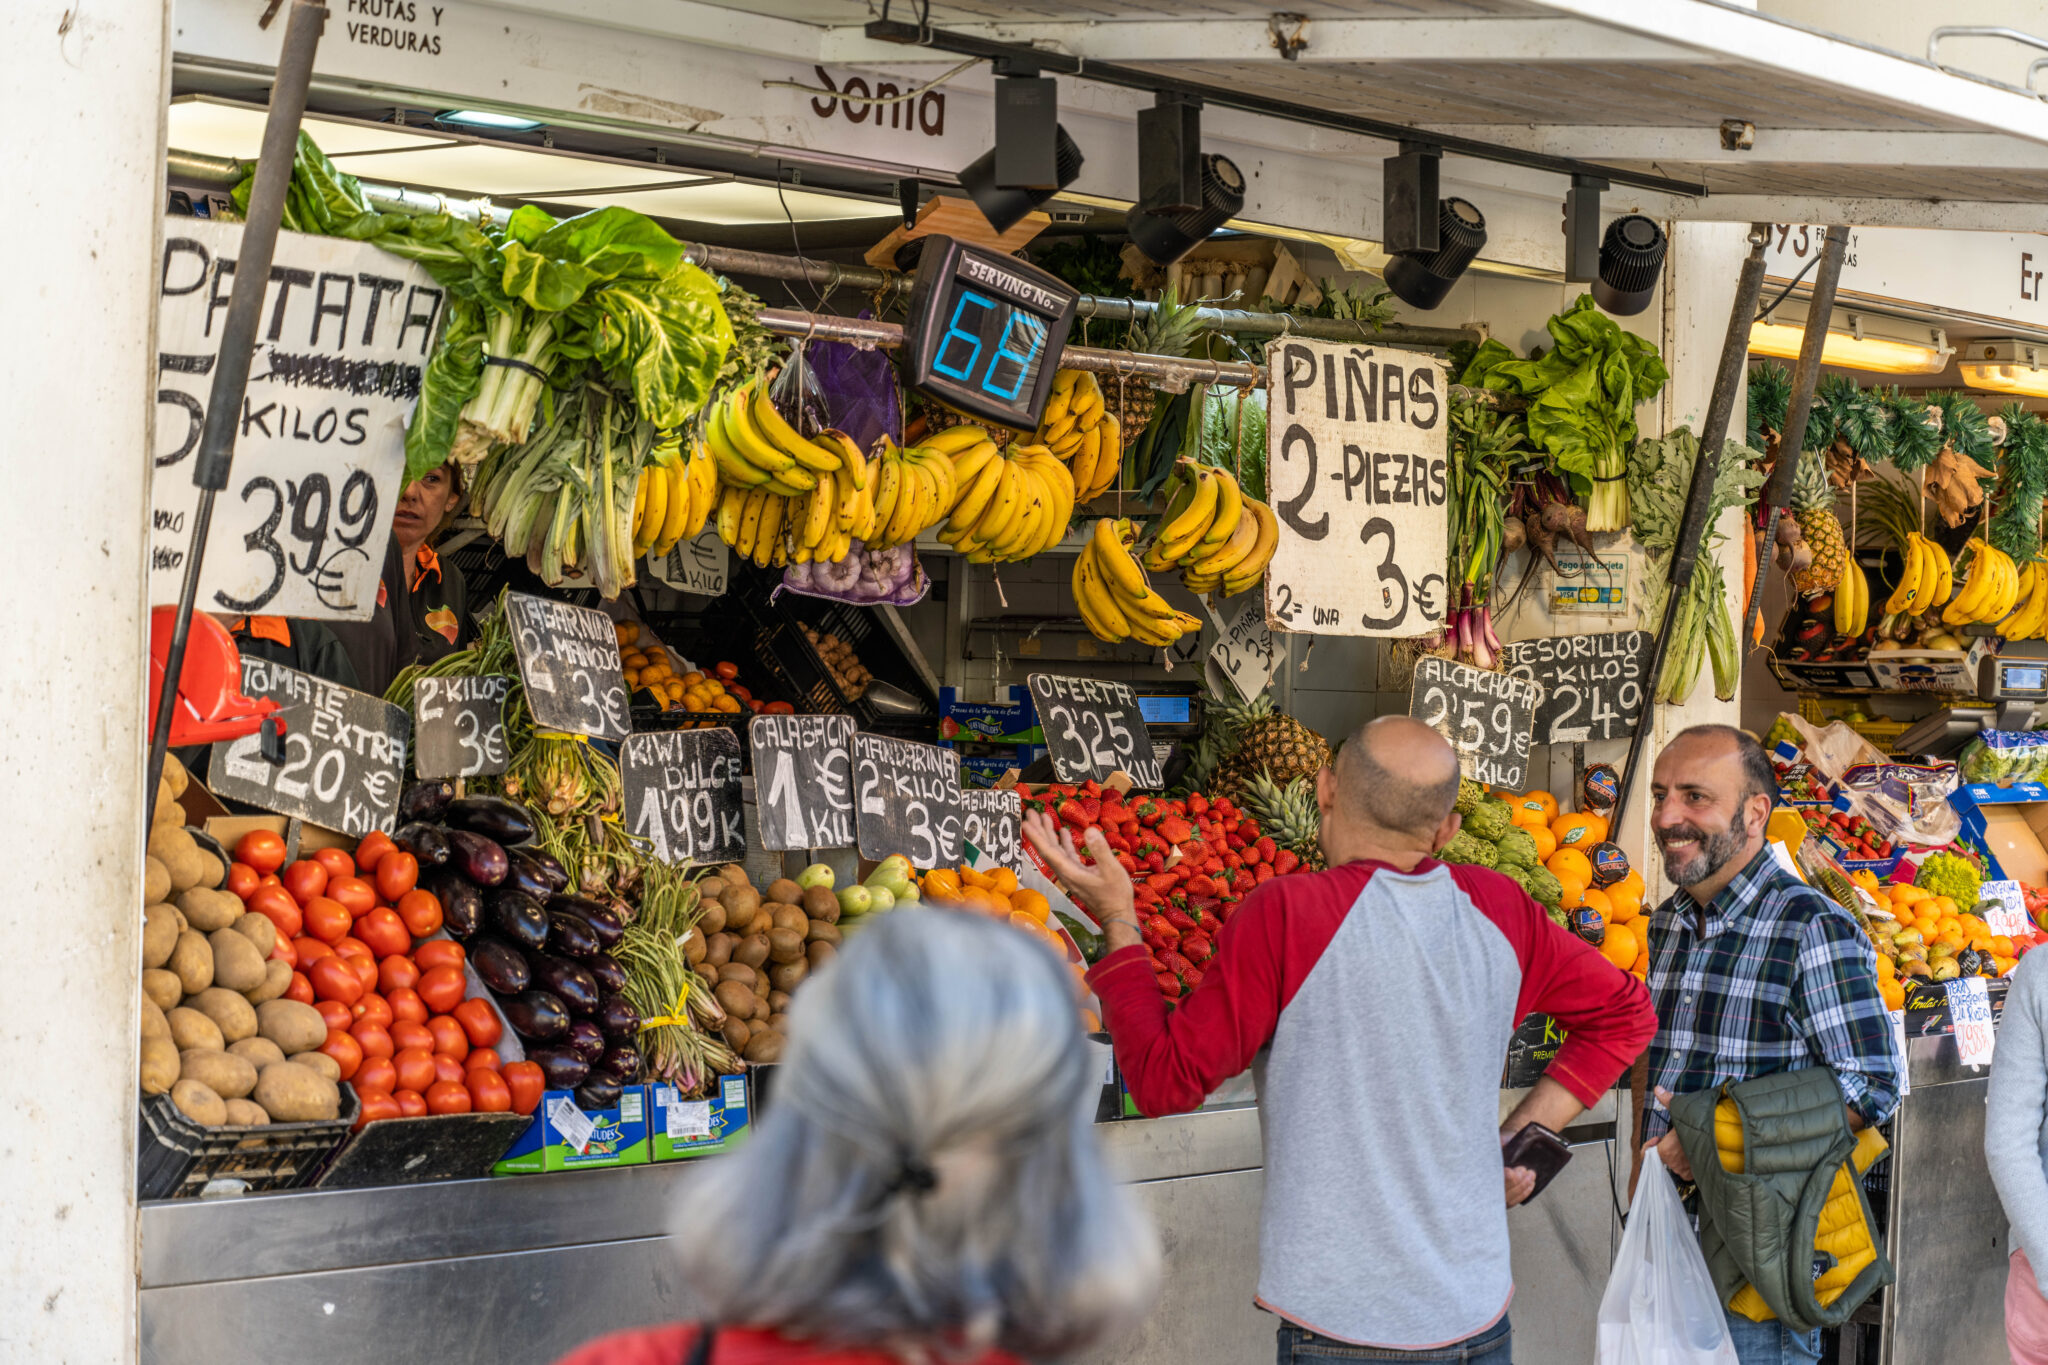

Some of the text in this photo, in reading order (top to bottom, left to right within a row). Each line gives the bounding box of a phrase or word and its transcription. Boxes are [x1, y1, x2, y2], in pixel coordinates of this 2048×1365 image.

[347, 0, 444, 26] FRUTAS Y
[347, 21, 441, 55] VERDURAS
[810, 65, 945, 136] Sonia
[968, 261, 1031, 299] SERVING
[2021, 252, 2043, 301] Er
[161, 236, 443, 356] PATATA
[1284, 344, 1439, 430] PIÑAS
[240, 396, 369, 446] KILOS
[689, 570, 723, 592] KILO
[1558, 561, 1578, 571] Pago
[1313, 605, 1340, 625] UNA
[1505, 630, 1641, 664] TESORILLO
[240, 656, 349, 720] TOMATE
[1037, 674, 1137, 708] OFERTA
[1425, 660, 1536, 711] ALCACHOFA
[310, 709, 406, 770] EXTRA
[628, 732, 684, 769] KIWI
[753, 715, 855, 750] CALABACIN
[663, 754, 742, 791] DULCE
[854, 736, 957, 784] MANDARINA
[1117, 755, 1164, 789] KILO
[1474, 755, 1521, 786] KILO
[961, 790, 1021, 815] AGUACATE
